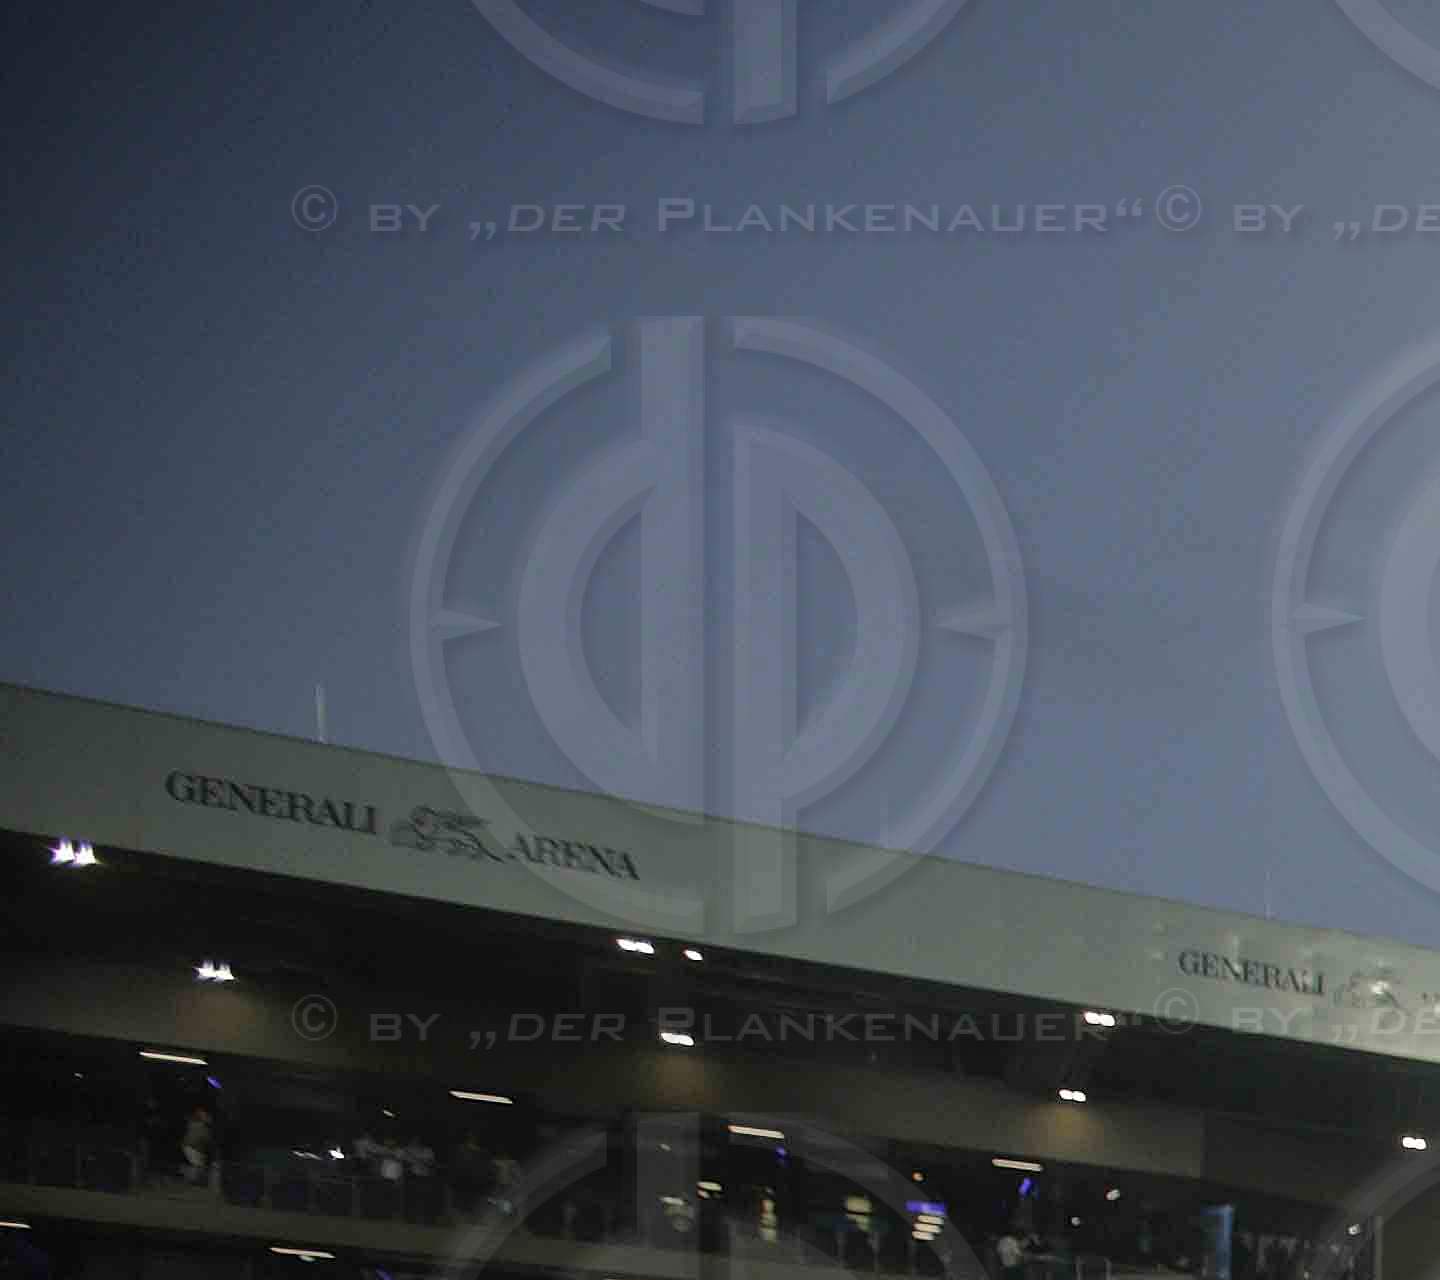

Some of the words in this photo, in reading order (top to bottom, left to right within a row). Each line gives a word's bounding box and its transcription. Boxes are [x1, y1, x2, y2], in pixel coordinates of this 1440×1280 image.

[165, 768, 378, 835] GENERALI
[513, 831, 640, 881] ARENA
[1177, 949, 1325, 997] GENERALI
